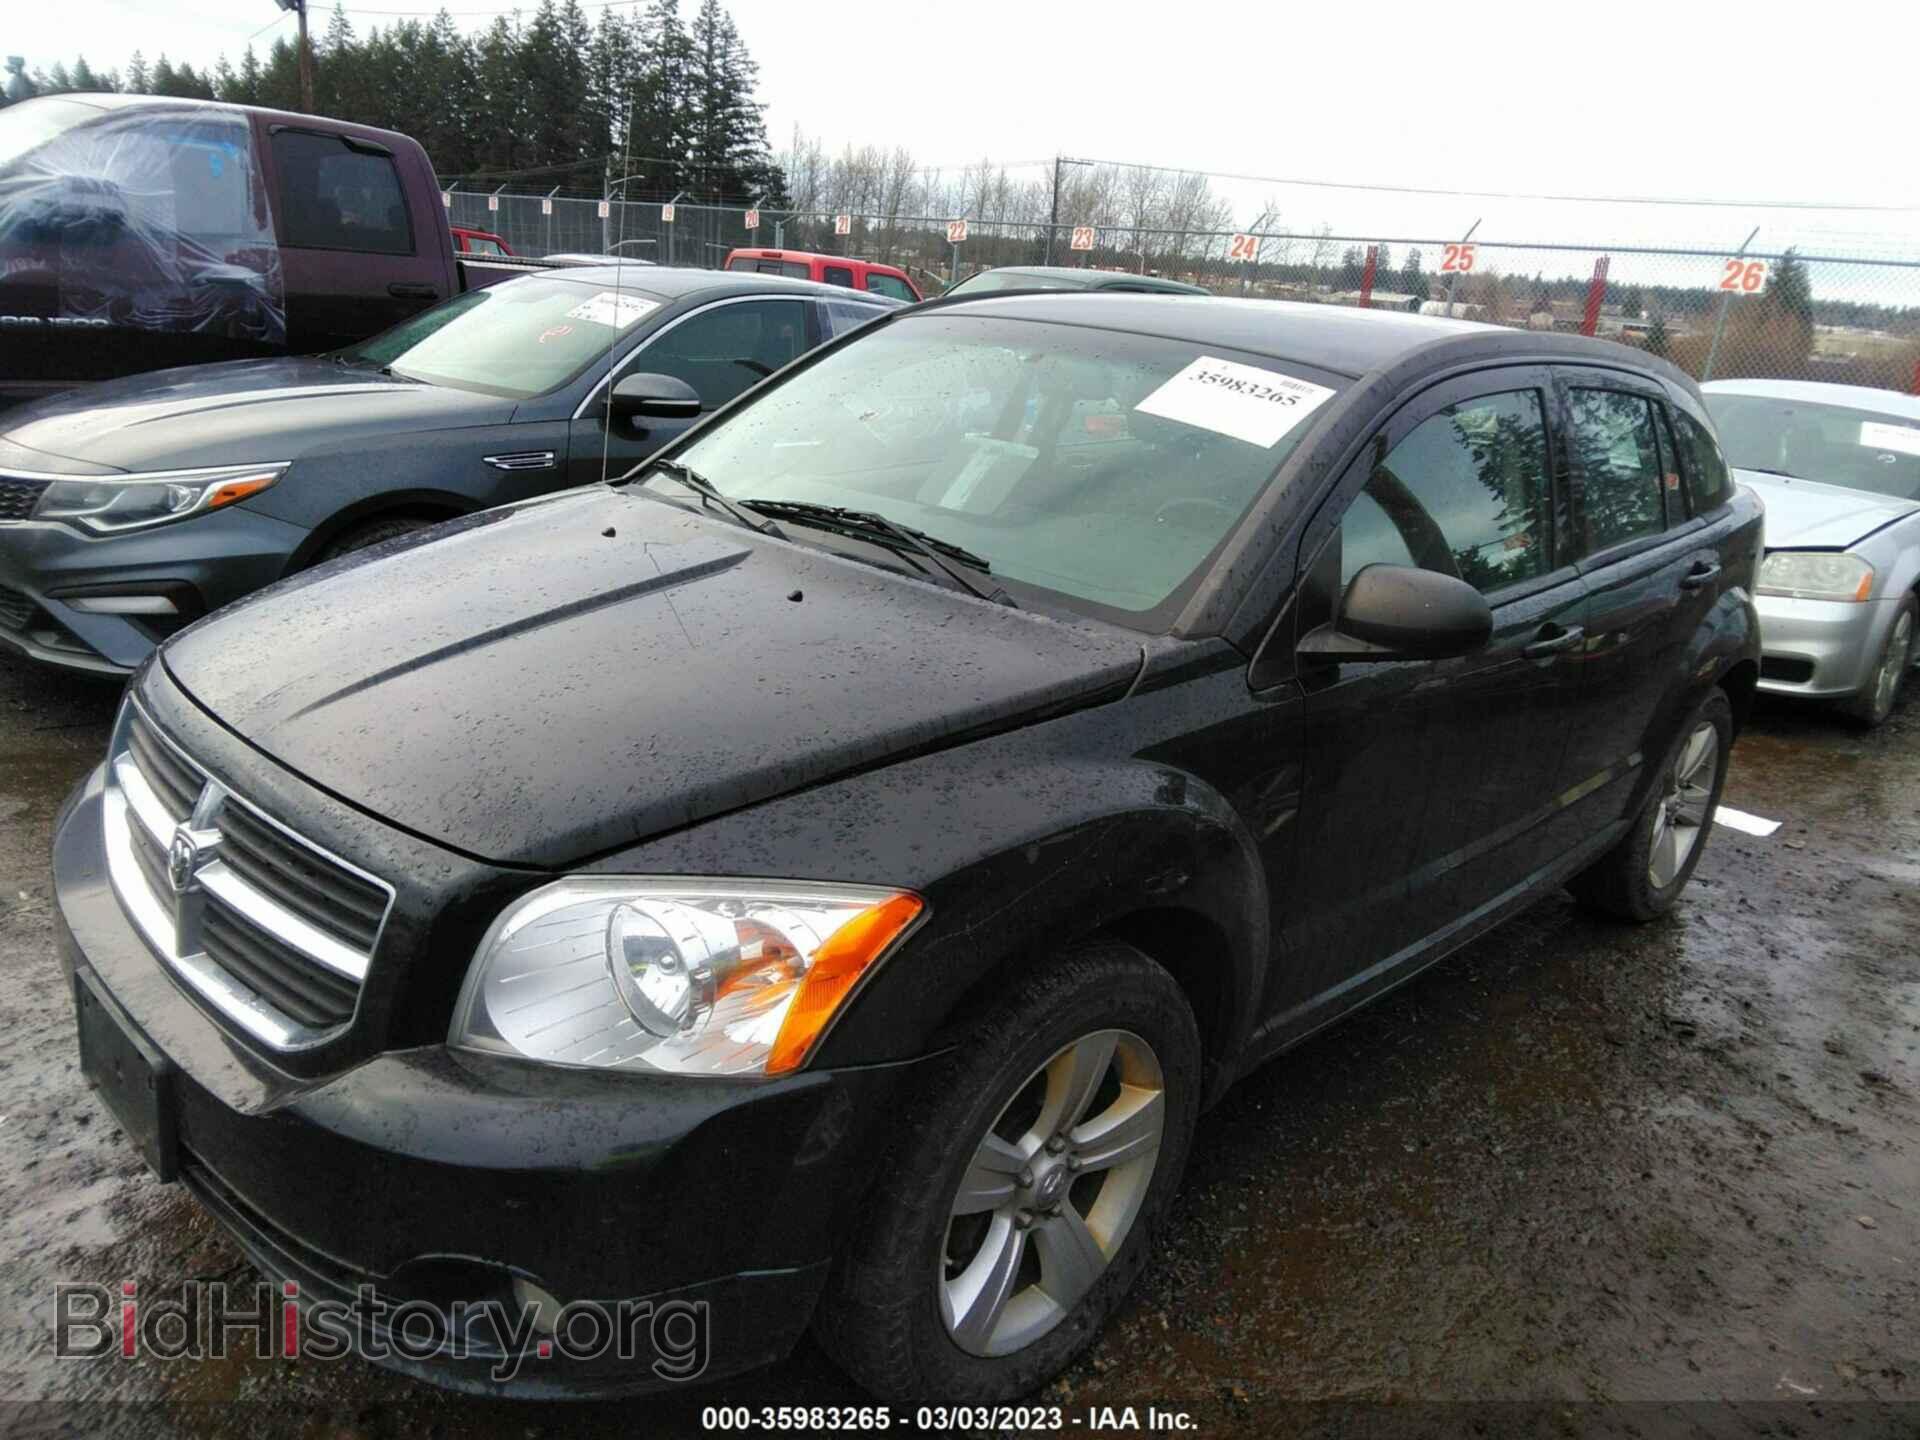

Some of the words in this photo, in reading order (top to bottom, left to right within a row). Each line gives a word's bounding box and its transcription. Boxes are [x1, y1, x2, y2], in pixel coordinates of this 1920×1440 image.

[746, 211, 758, 226] 20
[838, 216, 848, 233] 21
[949, 222, 965, 240] 22
[1073, 229, 1092, 248] 23
[1231, 235, 1255, 258] 24
[1441, 245, 1474, 271] 25
[1720, 260, 1764, 290] 26
[1187, 370, 1302, 407] 35983265
